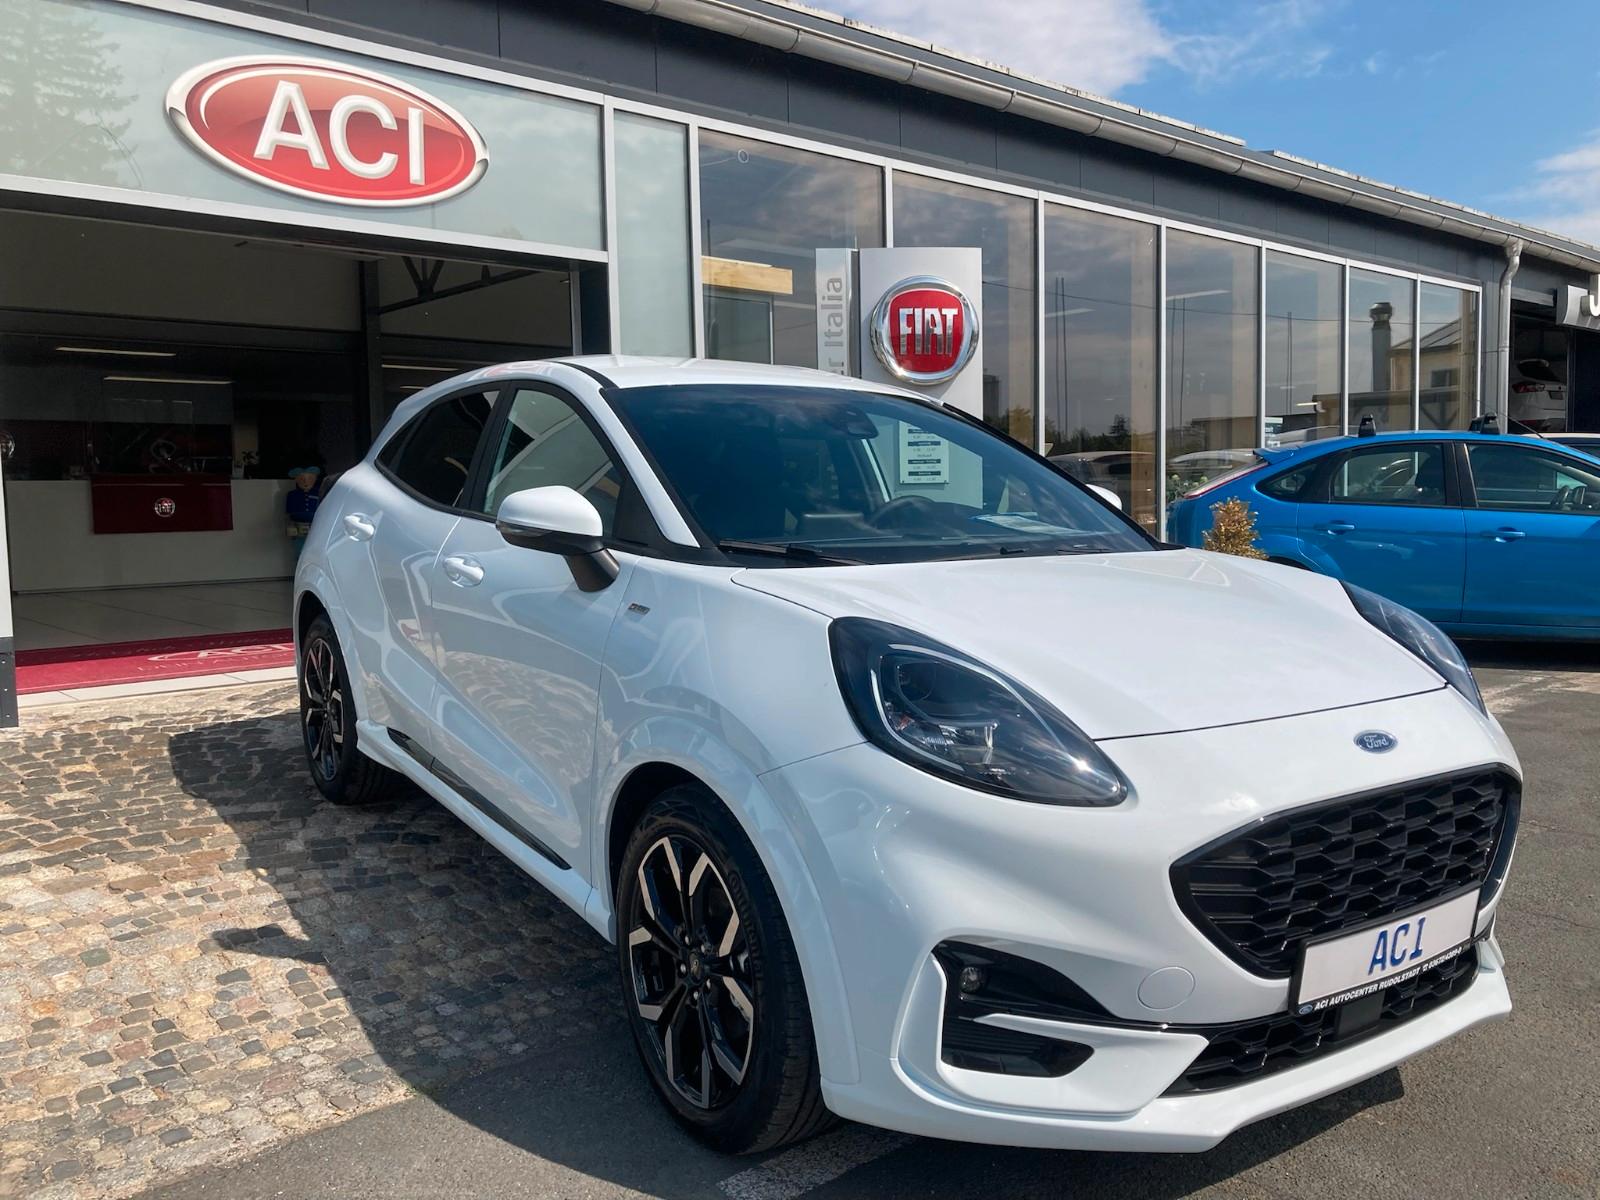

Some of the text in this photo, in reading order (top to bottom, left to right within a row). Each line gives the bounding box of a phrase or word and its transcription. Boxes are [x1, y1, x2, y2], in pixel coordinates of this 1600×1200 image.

[253, 79, 425, 185] ACI
[820, 276, 844, 348] Italia
[899, 307, 959, 357] FIAT
[1363, 734, 1389, 749] Ford
[1368, 917, 1426, 976] ACI
[1314, 999, 1329, 1011] ACI
[1329, 983, 1378, 1006] AUTOCENTER
[1379, 966, 1420, 990] RUDOLSTADT
